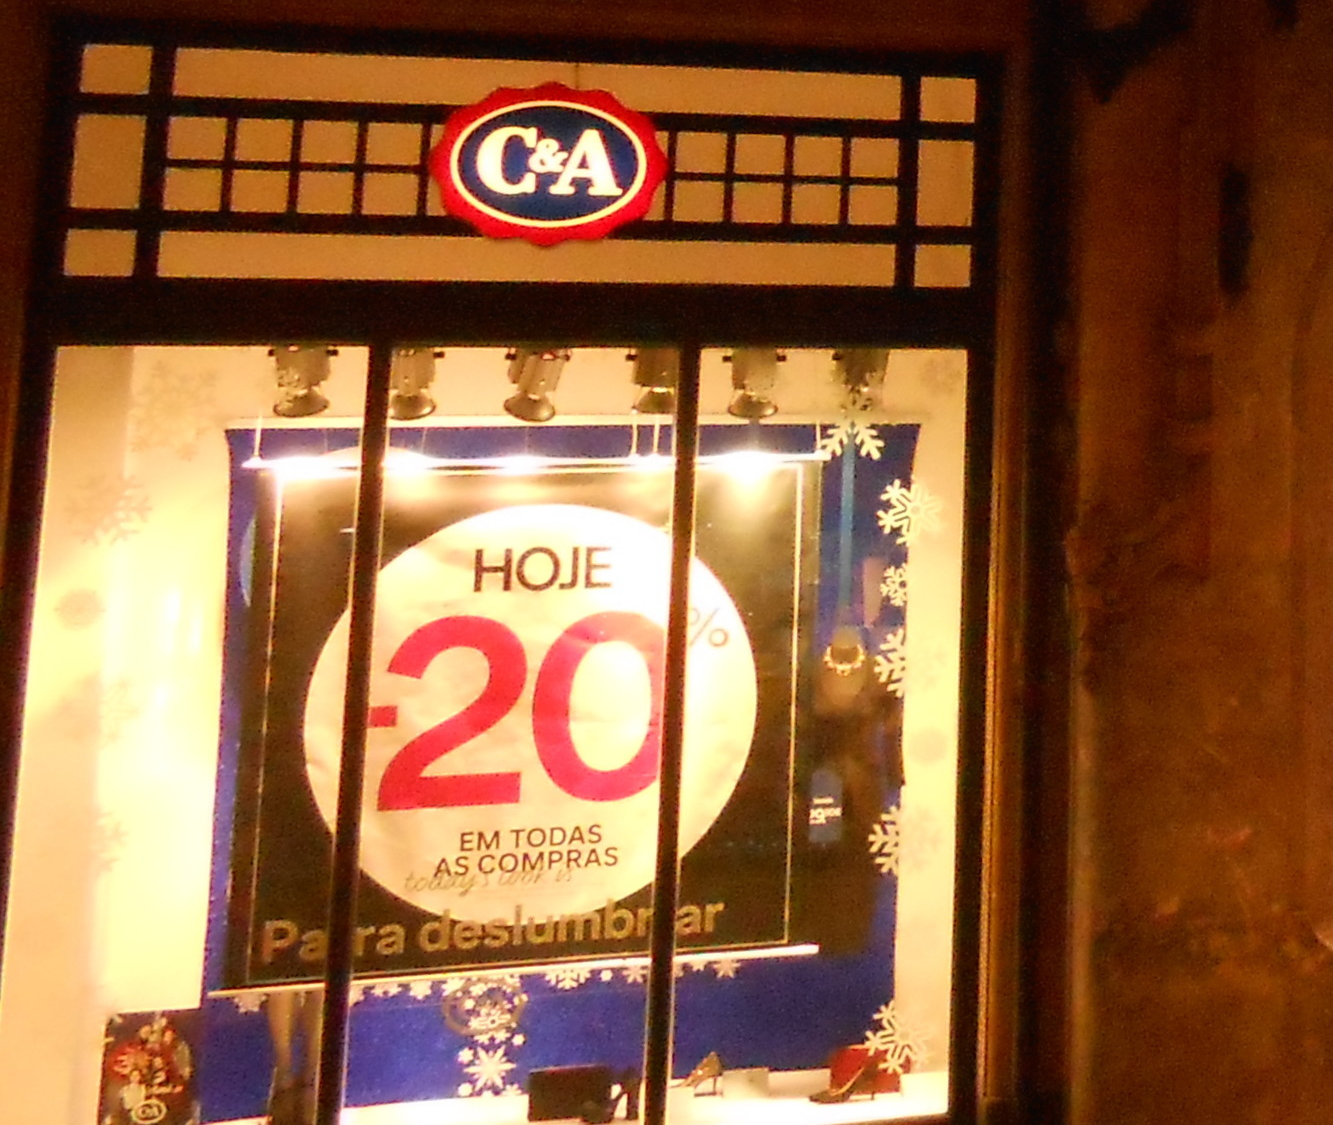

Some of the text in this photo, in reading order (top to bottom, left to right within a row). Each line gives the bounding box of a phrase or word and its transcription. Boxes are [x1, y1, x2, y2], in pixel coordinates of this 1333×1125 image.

[476, 126, 623, 196] C&A
[474, 547, 612, 593] HOJE
[460, 824, 604, 852] EM TODAS
[434, 847, 619, 877] AS COMPRAS
